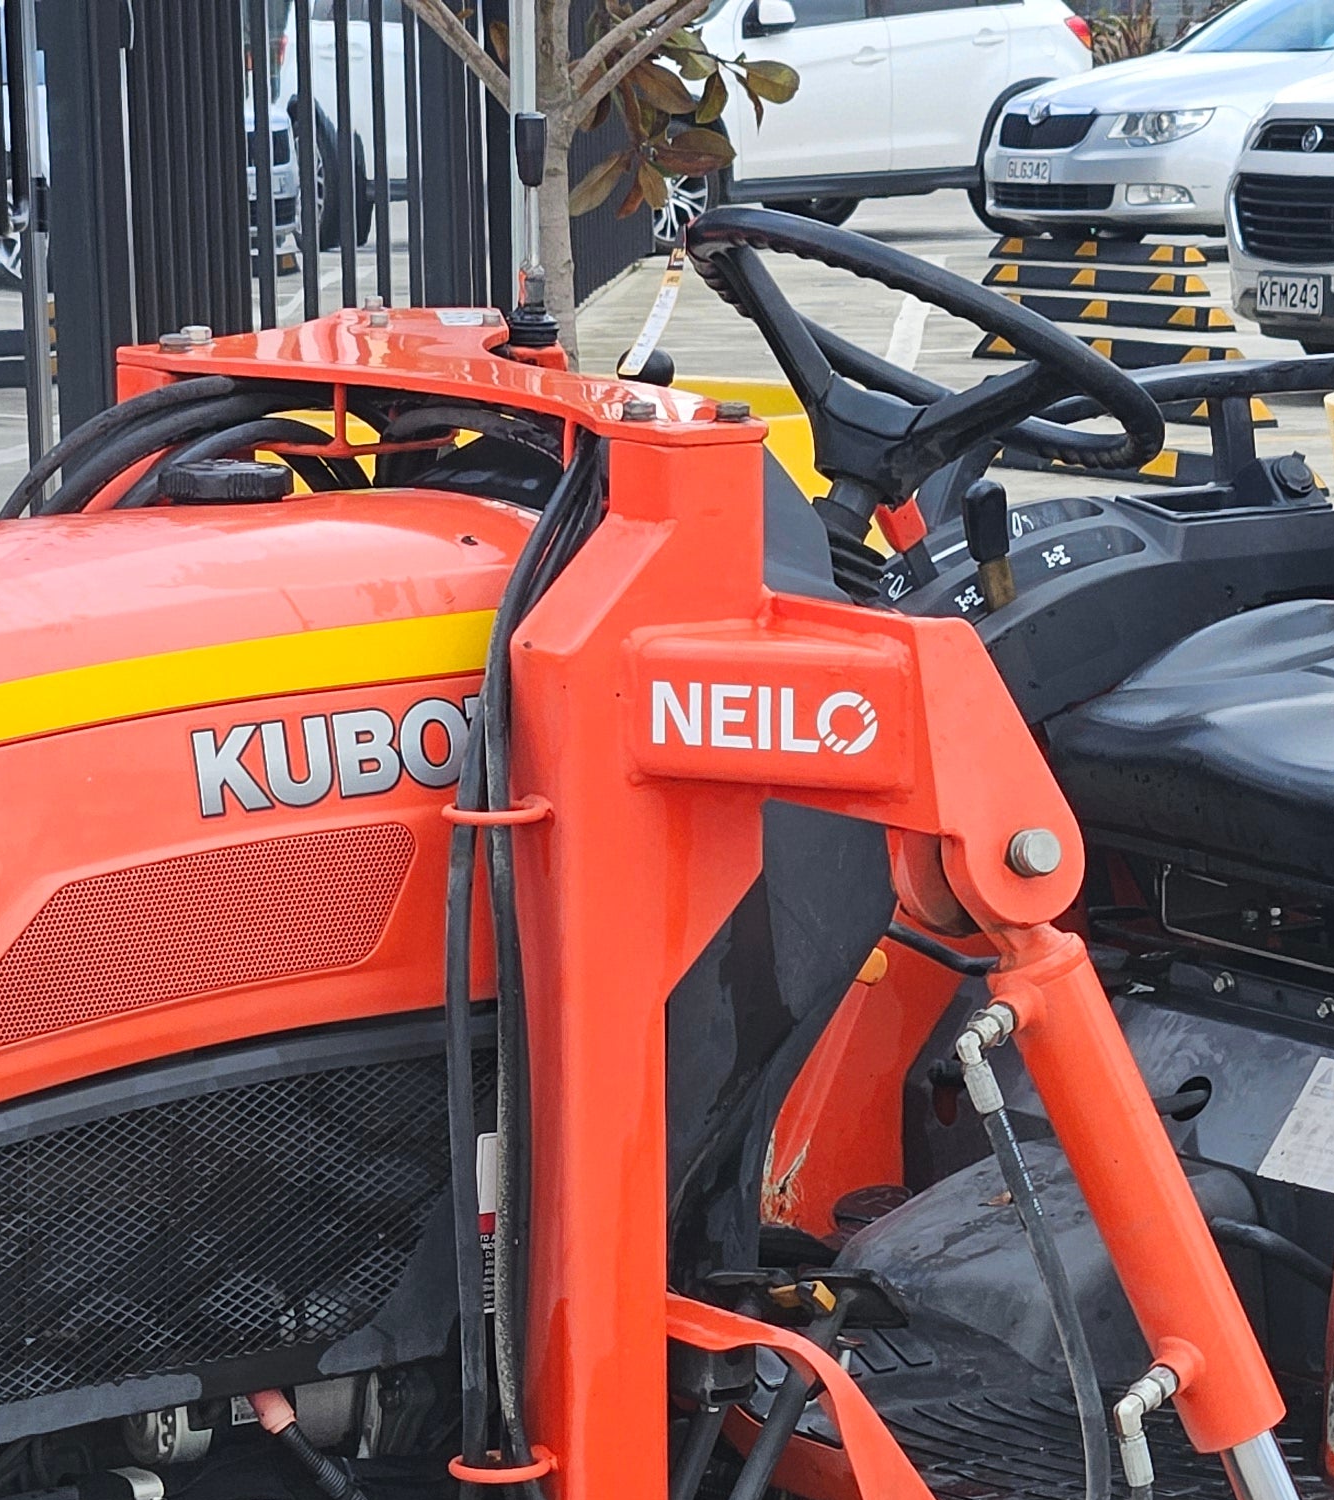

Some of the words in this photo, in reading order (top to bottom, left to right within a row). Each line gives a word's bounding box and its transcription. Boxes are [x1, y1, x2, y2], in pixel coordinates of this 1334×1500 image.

[1259, 281, 1319, 310] KFM243
[652, 680, 879, 755] NEILO
[190, 695, 483, 818] KUBO
